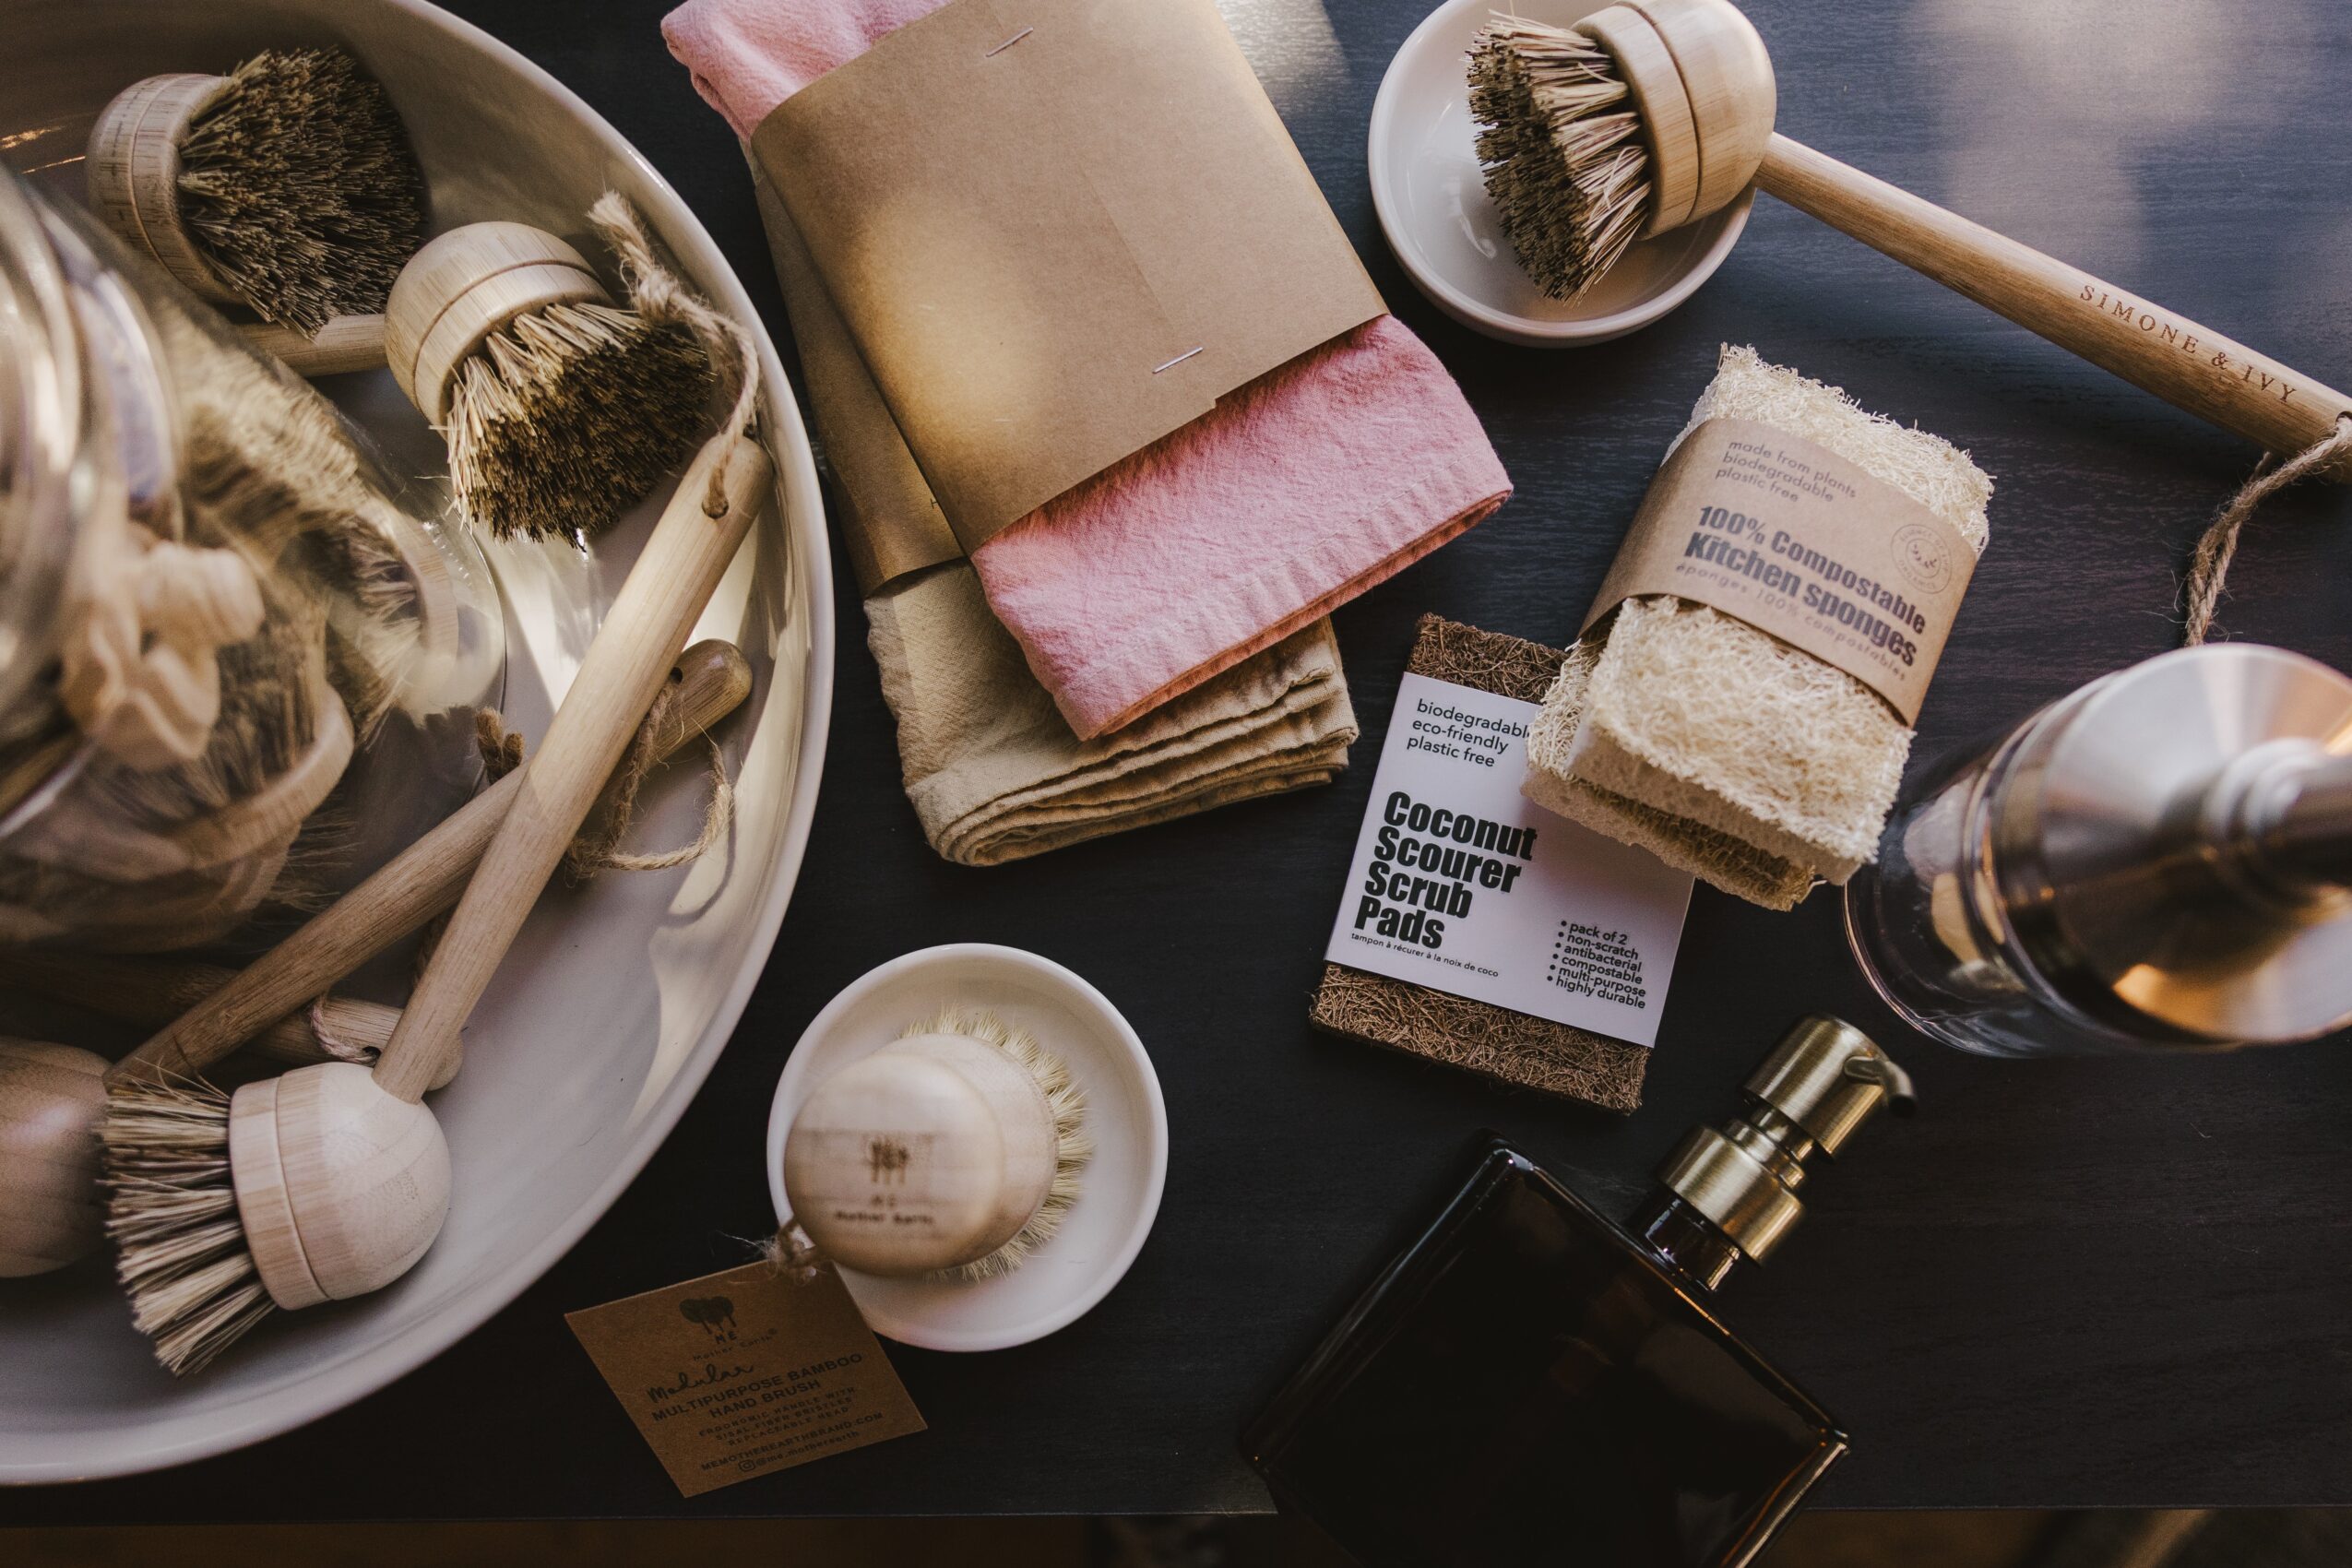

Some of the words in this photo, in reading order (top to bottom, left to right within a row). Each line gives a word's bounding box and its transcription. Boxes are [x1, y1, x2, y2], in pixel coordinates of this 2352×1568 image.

[2079, 284, 2199, 355] SIMONE
[2210, 350, 2230, 371] &
[2240, 365, 2298, 404] IVY
[1715, 466, 1765, 491] plastic
[1768, 481, 1800, 503] free
[1722, 451, 1834, 503] biodegradable
[1728, 439, 1772, 460] made
[1776, 451, 1811, 475] from
[1813, 469, 1857, 498] plants
[1698, 505, 1766, 545] 100%
[1770, 529, 1927, 636] Compostable
[1683, 531, 1801, 598] Kitchen
[1802, 582, 1917, 668] sponges
[1803, 614, 1907, 682] compostables
[1412, 719, 1509, 754] eco-friendly
[1417, 698, 1530, 739] biodegradabl
[1407, 735, 1460, 758] plastic
[1463, 747, 1495, 767] free
[1384, 790, 1538, 861] Coconut
[1374, 826, 1522, 893] Scourer
[1364, 861, 1473, 919] Scrub
[1354, 895, 1445, 949] Pads
[1569, 923, 1600, 938] pack
[1602, 932, 1618, 943] of
[1618, 933, 1628, 945] 2
[1351, 932, 1384, 947] tampon
[1393, 943, 1424, 958] récurer
[1433, 953, 1442, 962] la
[1443, 956, 1462, 968] noix
[1464, 961, 1476, 971] de
[1478, 967, 1499, 978] coco
[1563, 945, 1642, 972] antibacterial
[1567, 934, 1639, 960] non-scratch
[1559, 968, 1646, 997] multi-purpose
[1562, 956, 1643, 984] compostable
[1556, 975, 1595, 997] highly
[1597, 988, 1645, 1009] durable
[652, 1375, 783, 1421] MULTIPURPOSE
[788, 1352, 863, 1382] BAMBOO
[708, 1396, 757, 1419] HAND
[762, 1379, 821, 1403] BRUSH
[774, 1396, 821, 1414] HANDLE
[826, 1386, 856, 1399] WITH
[817, 1406, 849, 1420] HEAD
